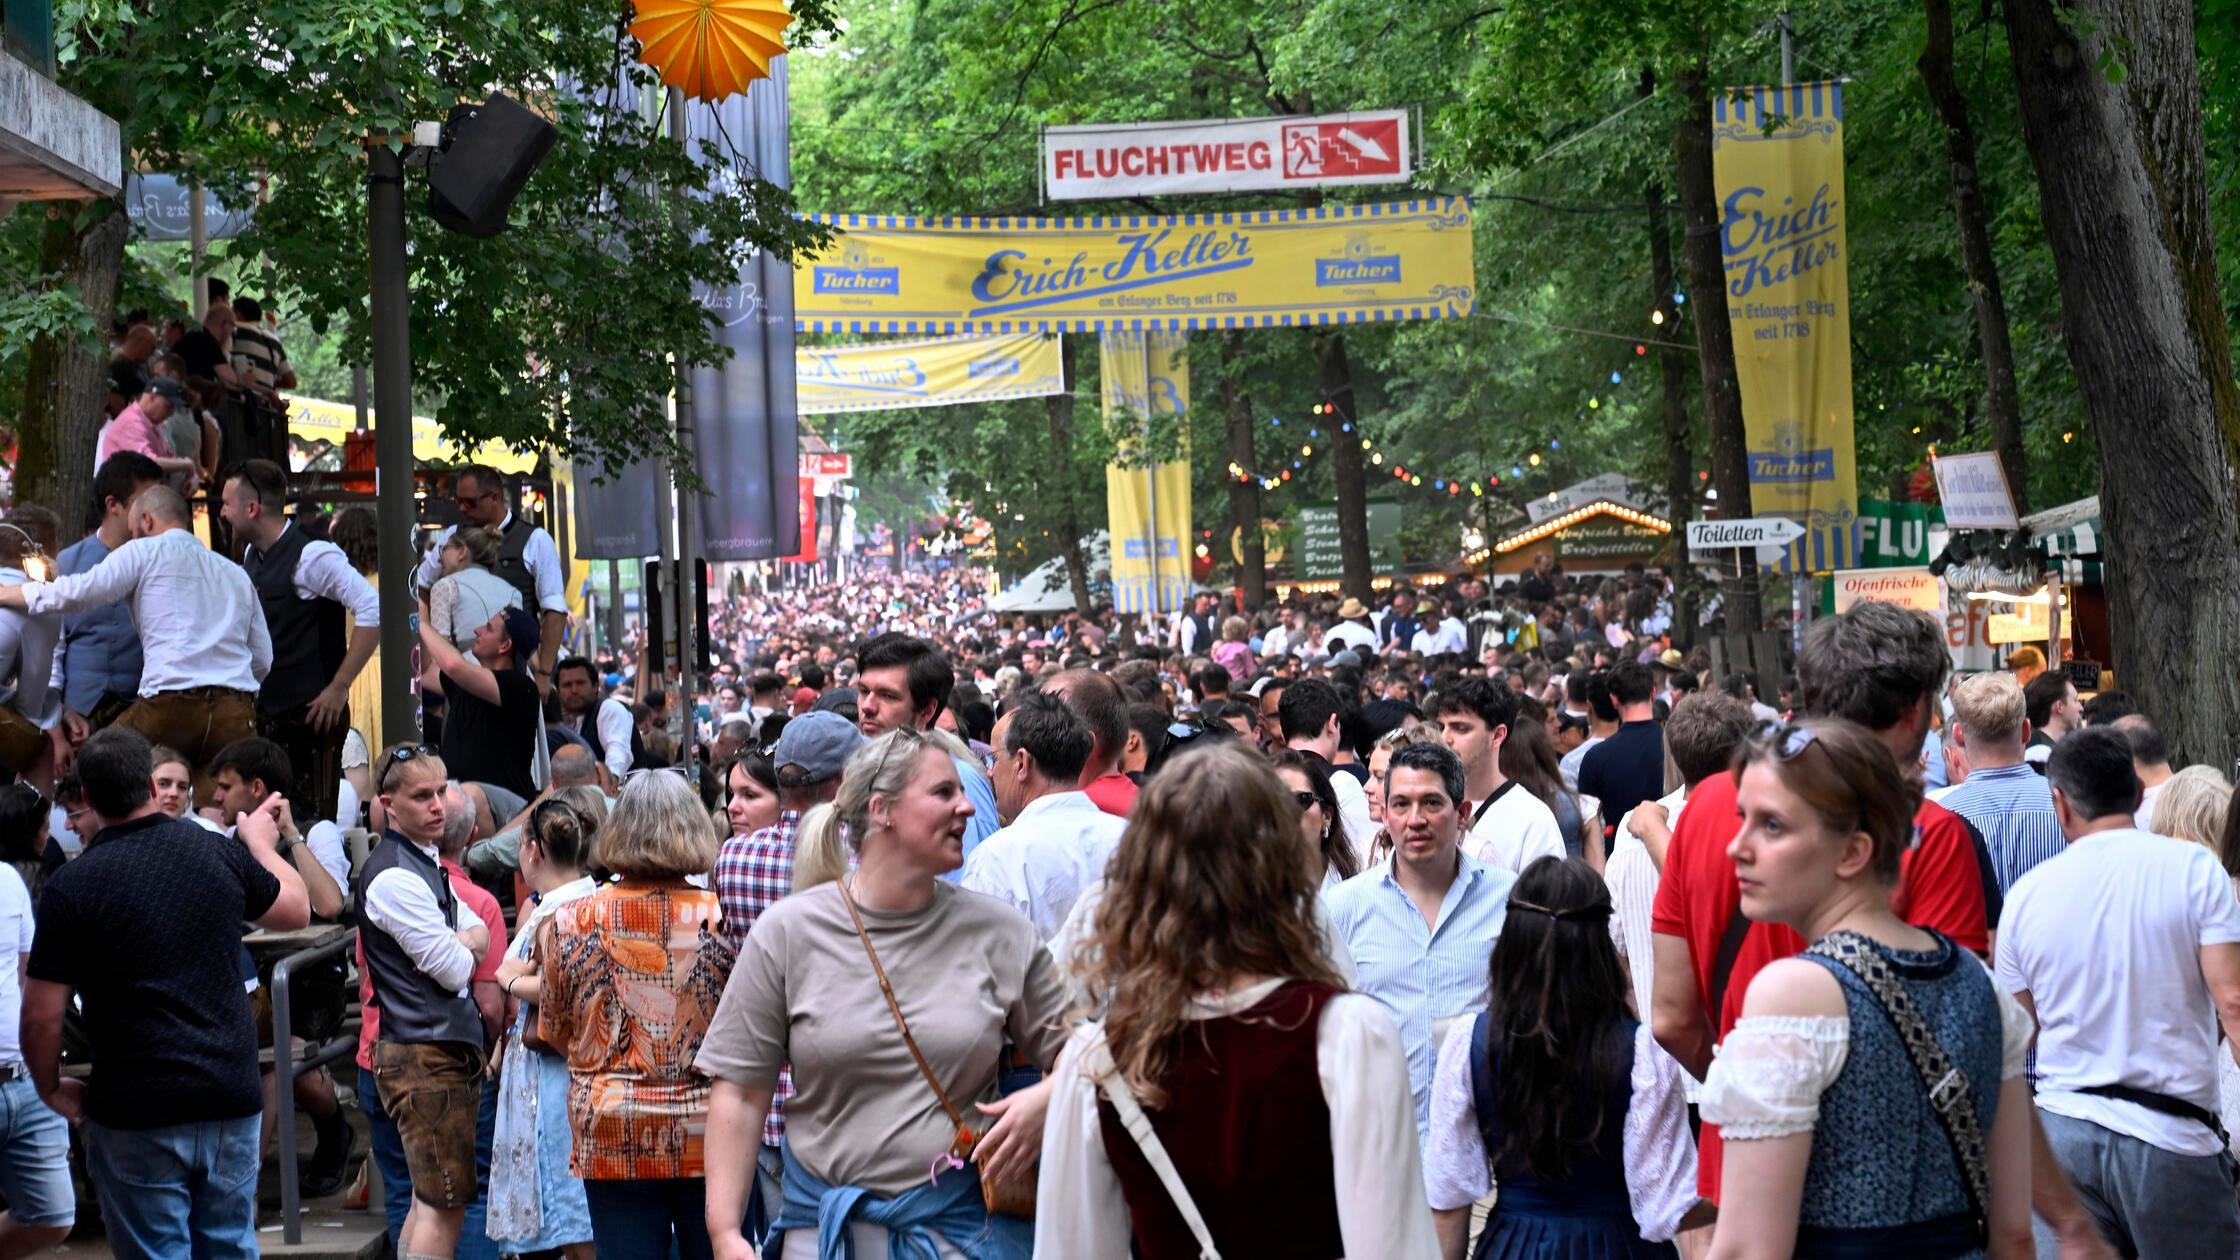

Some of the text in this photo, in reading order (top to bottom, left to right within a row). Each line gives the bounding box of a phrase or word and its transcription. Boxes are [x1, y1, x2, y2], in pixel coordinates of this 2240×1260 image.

[1055, 141, 1272, 180] FLUCHTWEG
[1720, 183, 1838, 257] Erich-
[971, 229, 1253, 303] Erich-Keller
[1324, 263, 1394, 280] Tucher
[1723, 241, 1839, 297] Keller
[822, 272, 893, 289] Tucher
[1728, 300, 1836, 320] m Erlanger Berg
[1755, 458, 1826, 477] Tucher
[1692, 525, 1764, 545] Toiletten
[1844, 575, 1929, 595] Ofenfrische
